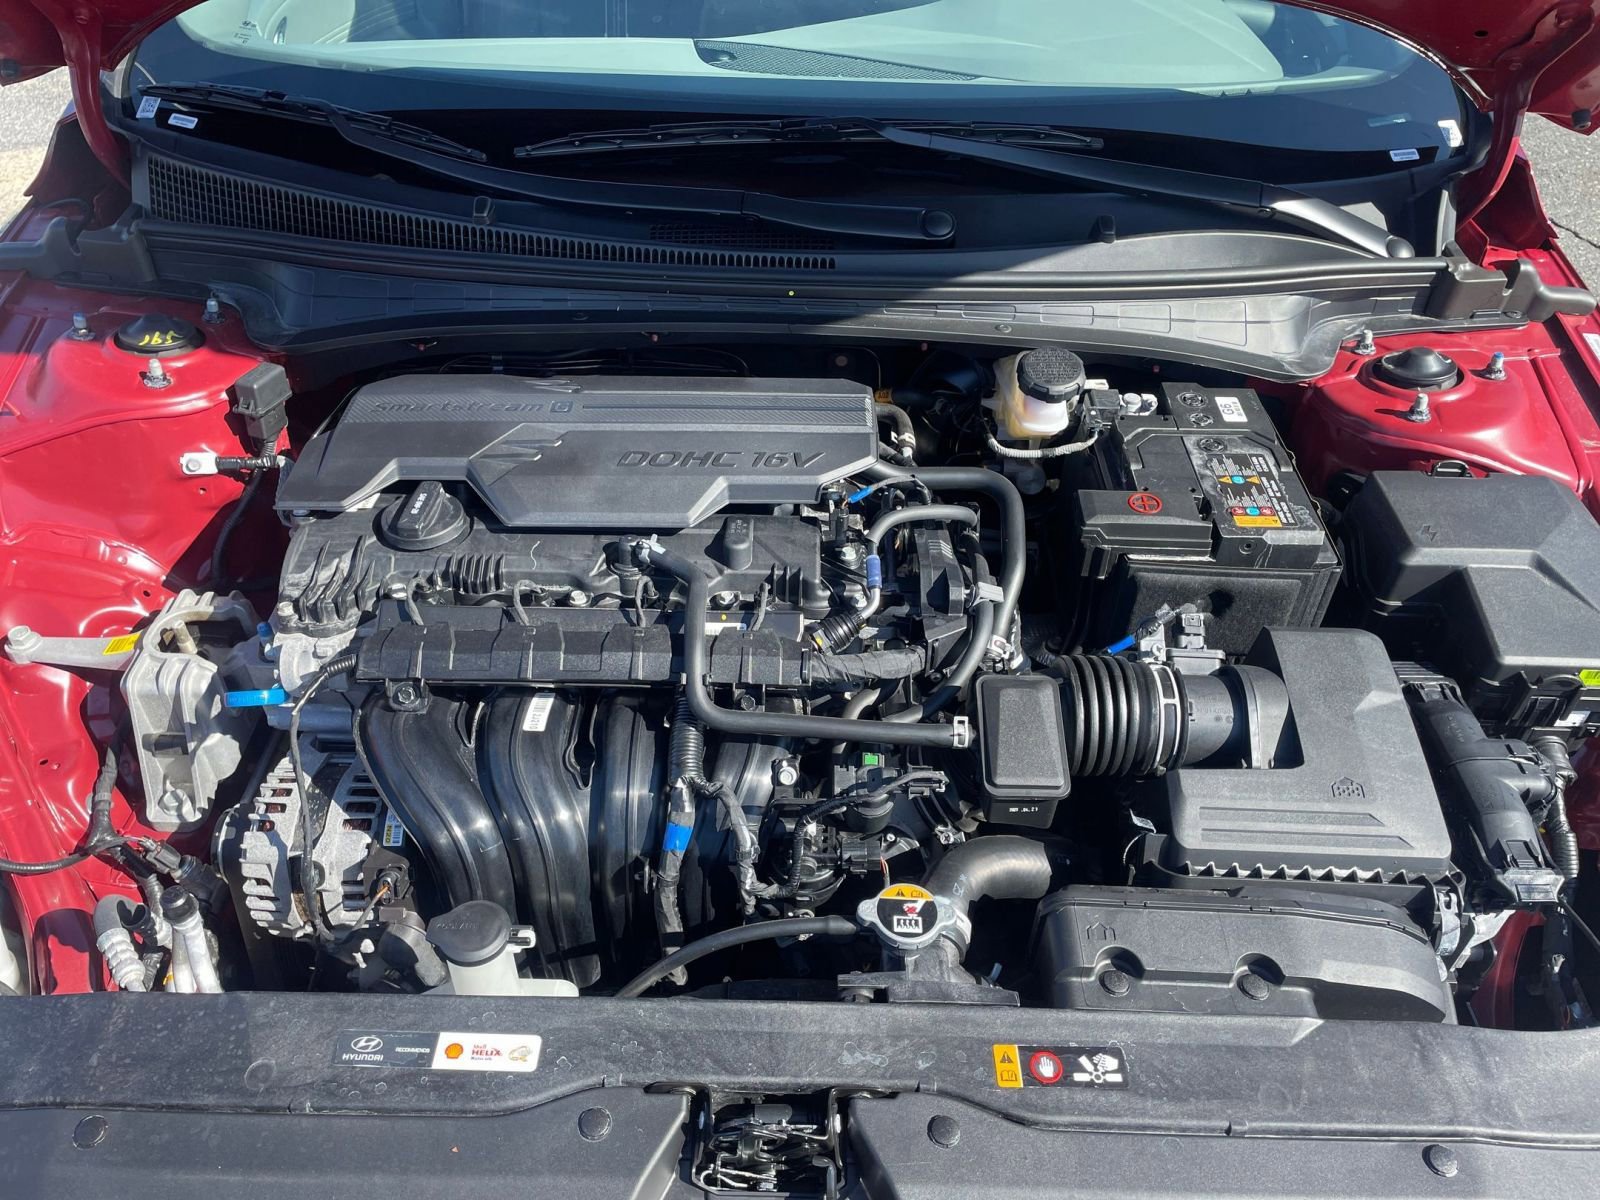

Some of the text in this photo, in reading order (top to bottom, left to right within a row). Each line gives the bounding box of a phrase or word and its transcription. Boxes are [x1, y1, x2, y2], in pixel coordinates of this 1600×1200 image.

[616, 451, 826, 468] DOHC 16V
[342, 1053, 384, 1062] HYUNDAI
